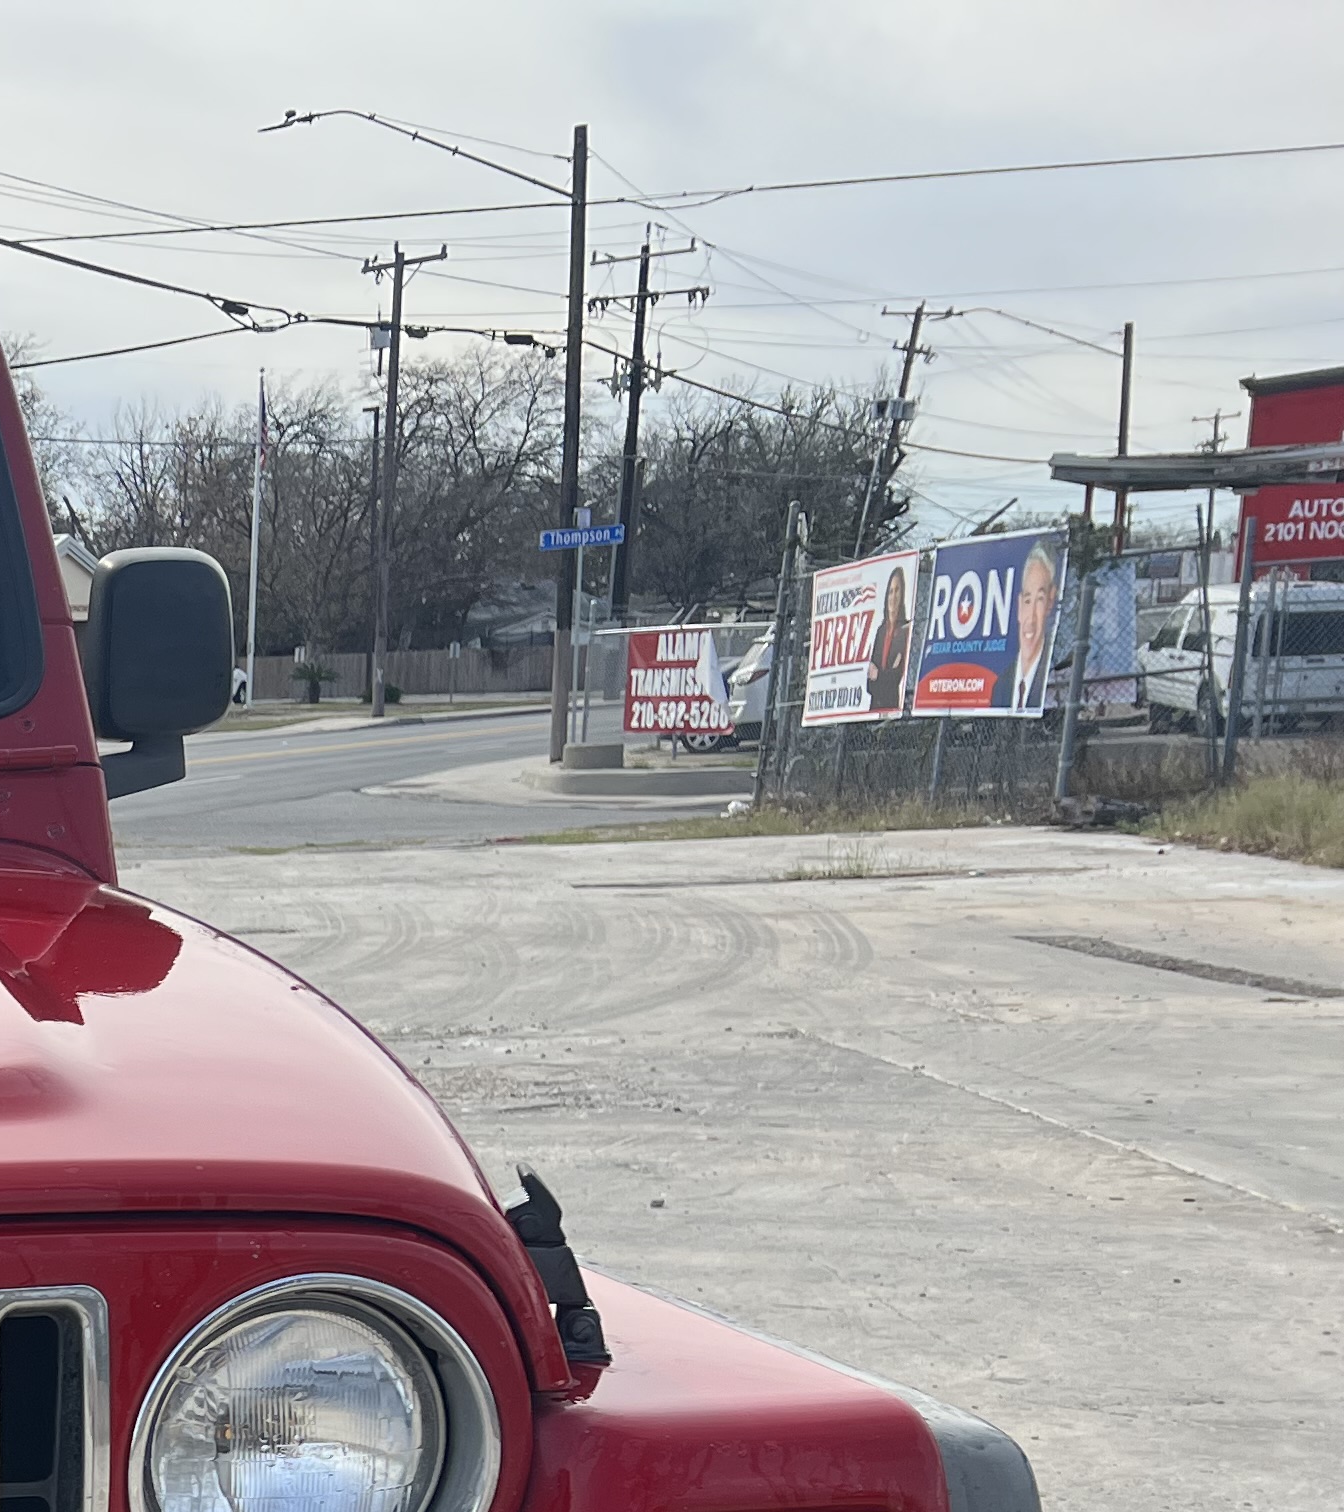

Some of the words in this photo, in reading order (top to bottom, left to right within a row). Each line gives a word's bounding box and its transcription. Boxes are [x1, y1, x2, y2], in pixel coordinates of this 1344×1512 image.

[550, 528, 611, 547] Thompson
[1263, 521, 1305, 542] 2101
[928, 567, 1015, 641] RON
[811, 609, 875, 671] PEREZ
[952, 640, 984, 653] COUNTY
[929, 677, 985, 693] VOTERON.COM
